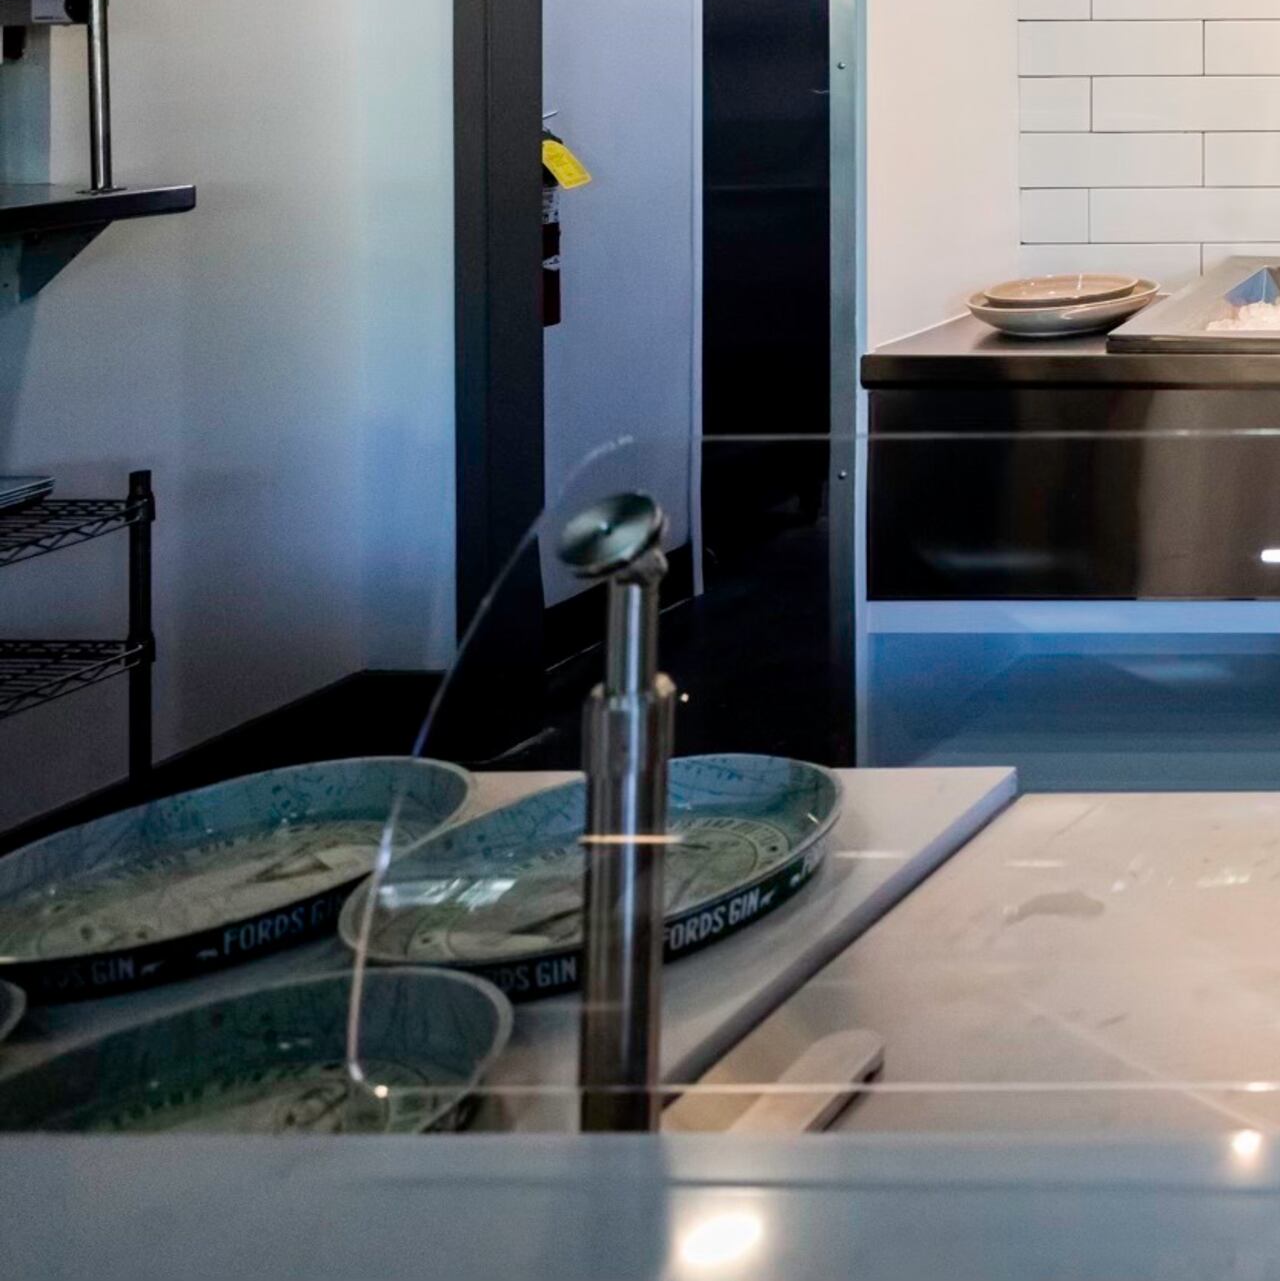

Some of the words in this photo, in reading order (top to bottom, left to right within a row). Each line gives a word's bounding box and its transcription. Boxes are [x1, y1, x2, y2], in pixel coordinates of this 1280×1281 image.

[729, 887, 760, 926] GIN
[223, 908, 305, 955] FORDS
[91, 955, 134, 986] GIN
[535, 955, 577, 988] GIN
